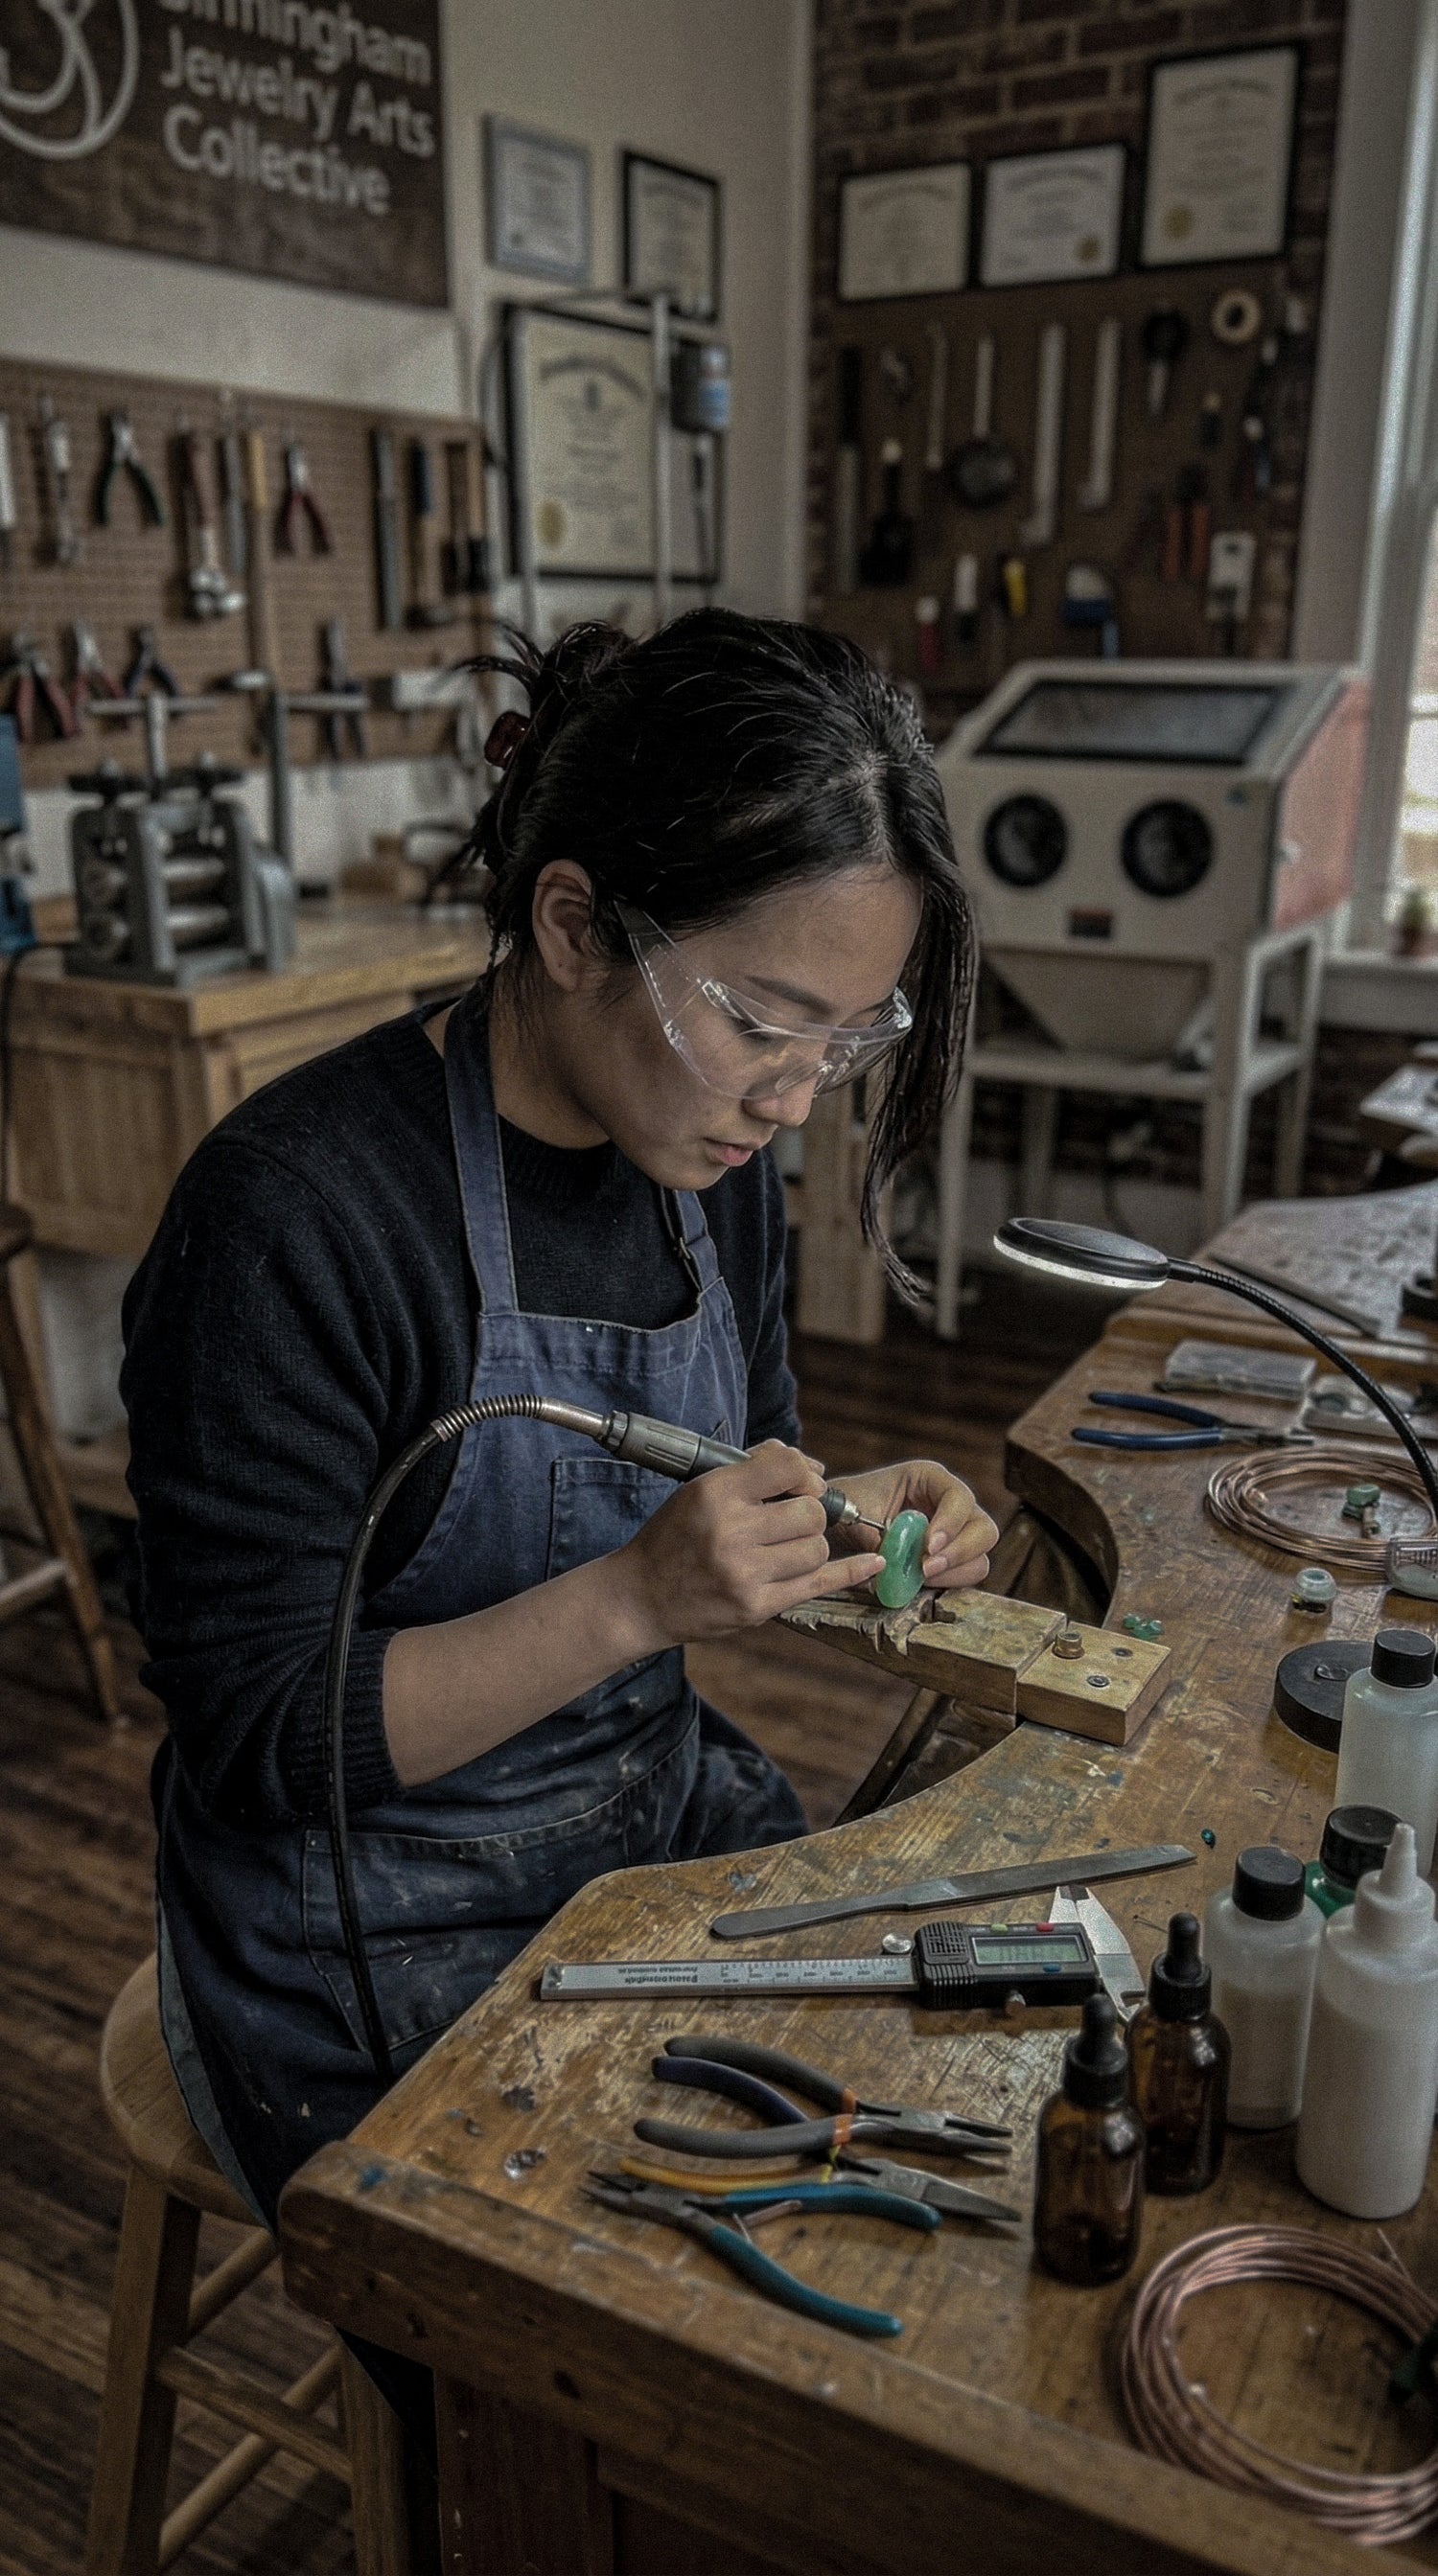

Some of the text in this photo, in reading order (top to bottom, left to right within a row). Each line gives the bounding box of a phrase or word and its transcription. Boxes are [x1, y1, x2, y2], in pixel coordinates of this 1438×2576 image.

[159, 0, 430, 85] mingham
[161, 26, 434, 158] Jewelry Arts
[164, 104, 390, 215] Collective
